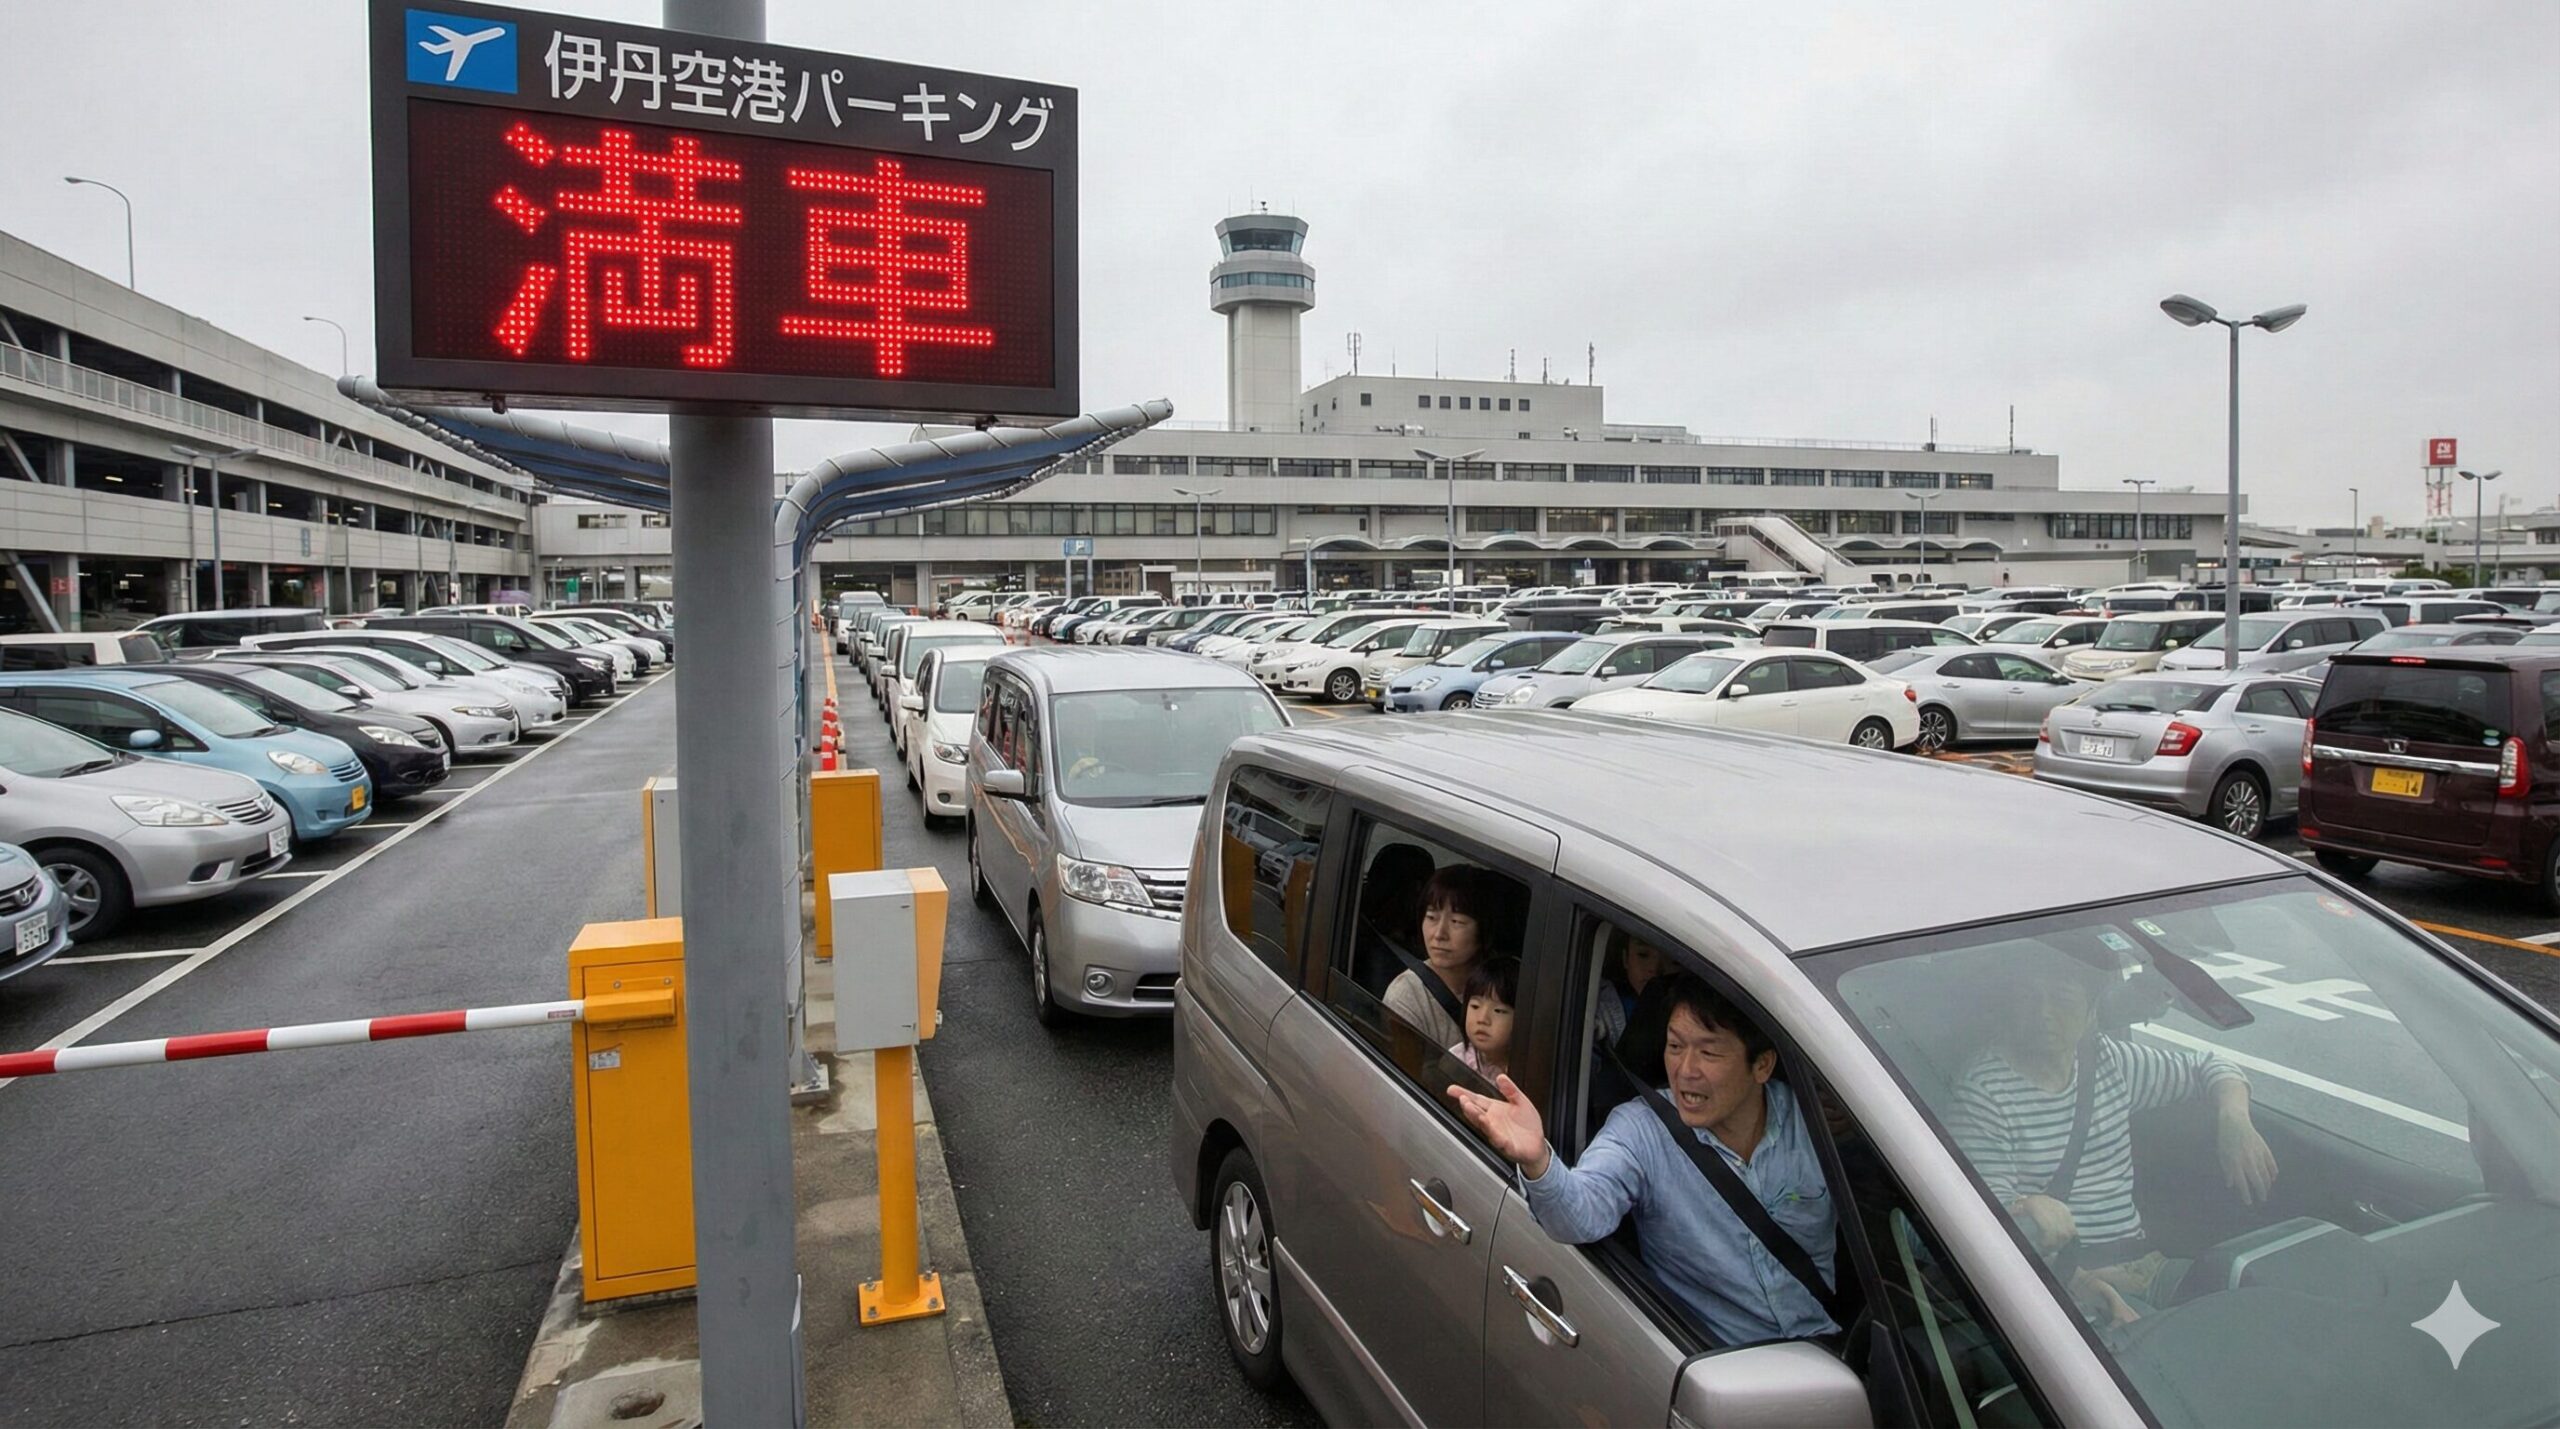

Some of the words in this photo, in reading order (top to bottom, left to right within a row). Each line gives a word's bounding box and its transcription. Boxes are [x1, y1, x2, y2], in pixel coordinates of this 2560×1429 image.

[544, 30, 1054, 151] 伊丹空港パーキング
[493, 122, 996, 377] 満車
